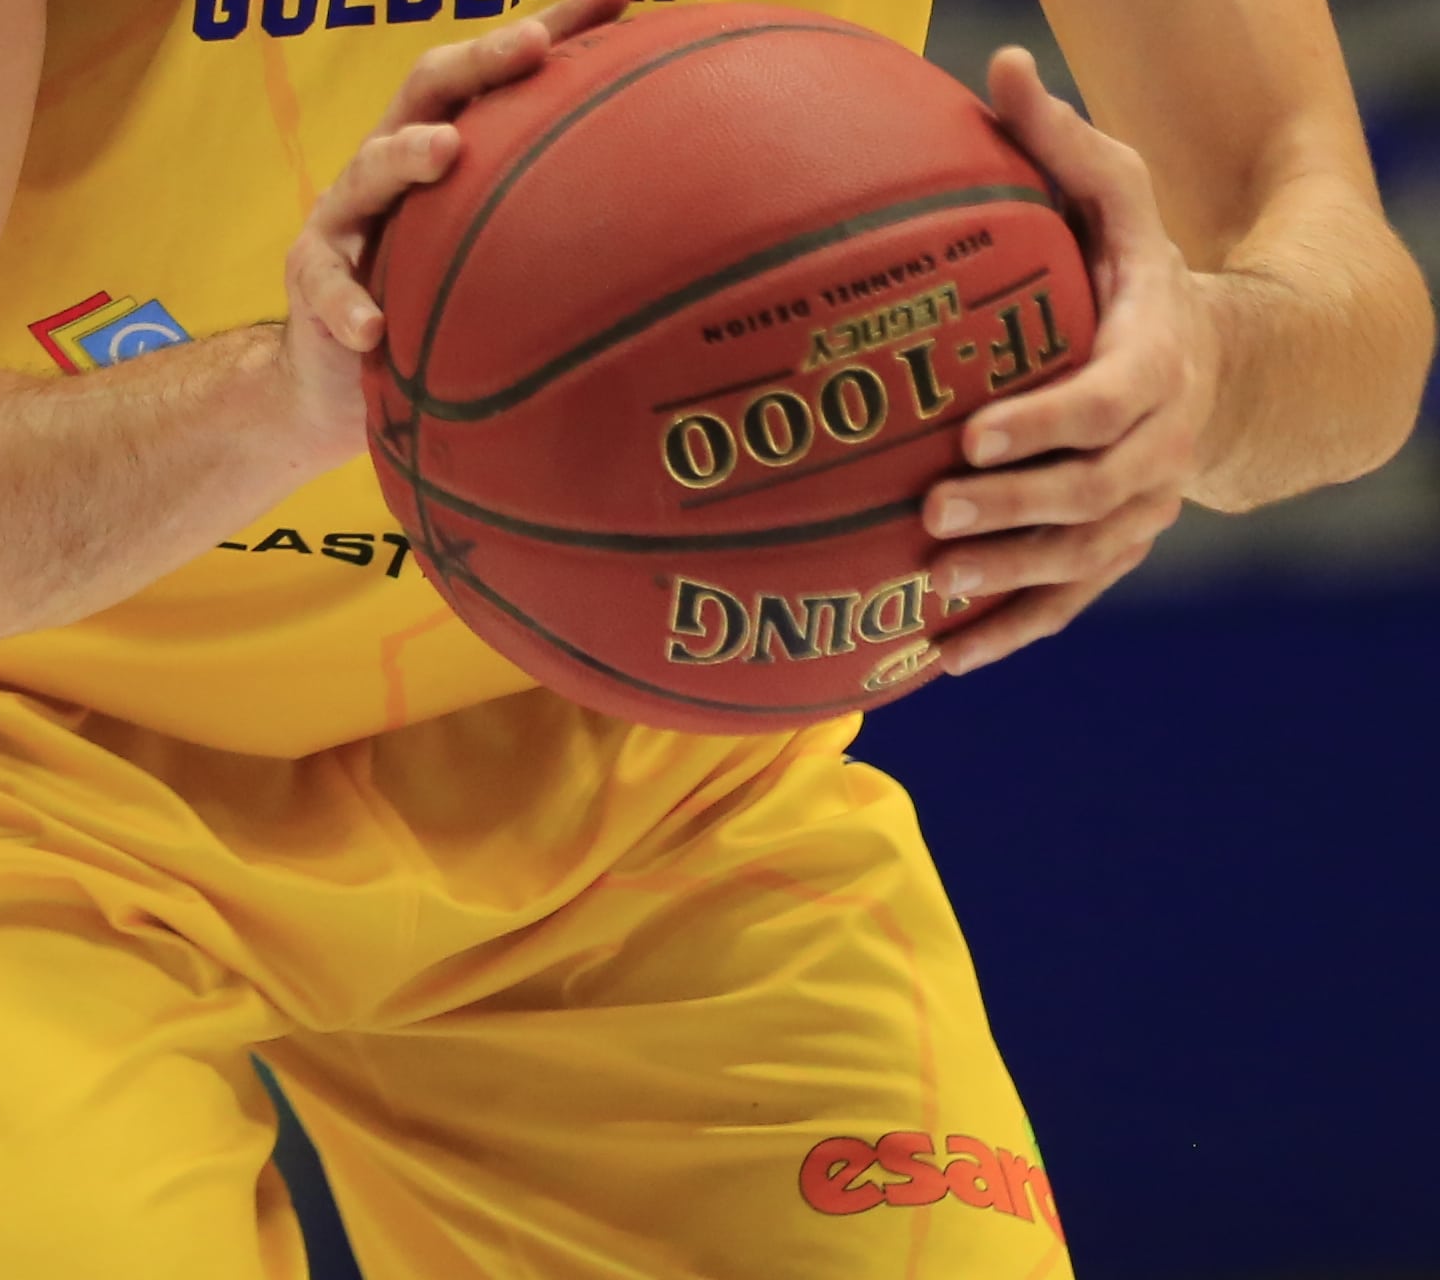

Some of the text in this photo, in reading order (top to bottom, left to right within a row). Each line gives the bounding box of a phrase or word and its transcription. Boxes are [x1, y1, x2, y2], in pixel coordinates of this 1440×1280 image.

[701, 229, 994, 345] DEEP CHANNEL DESIGN
[801, 280, 960, 373] LEGACY
